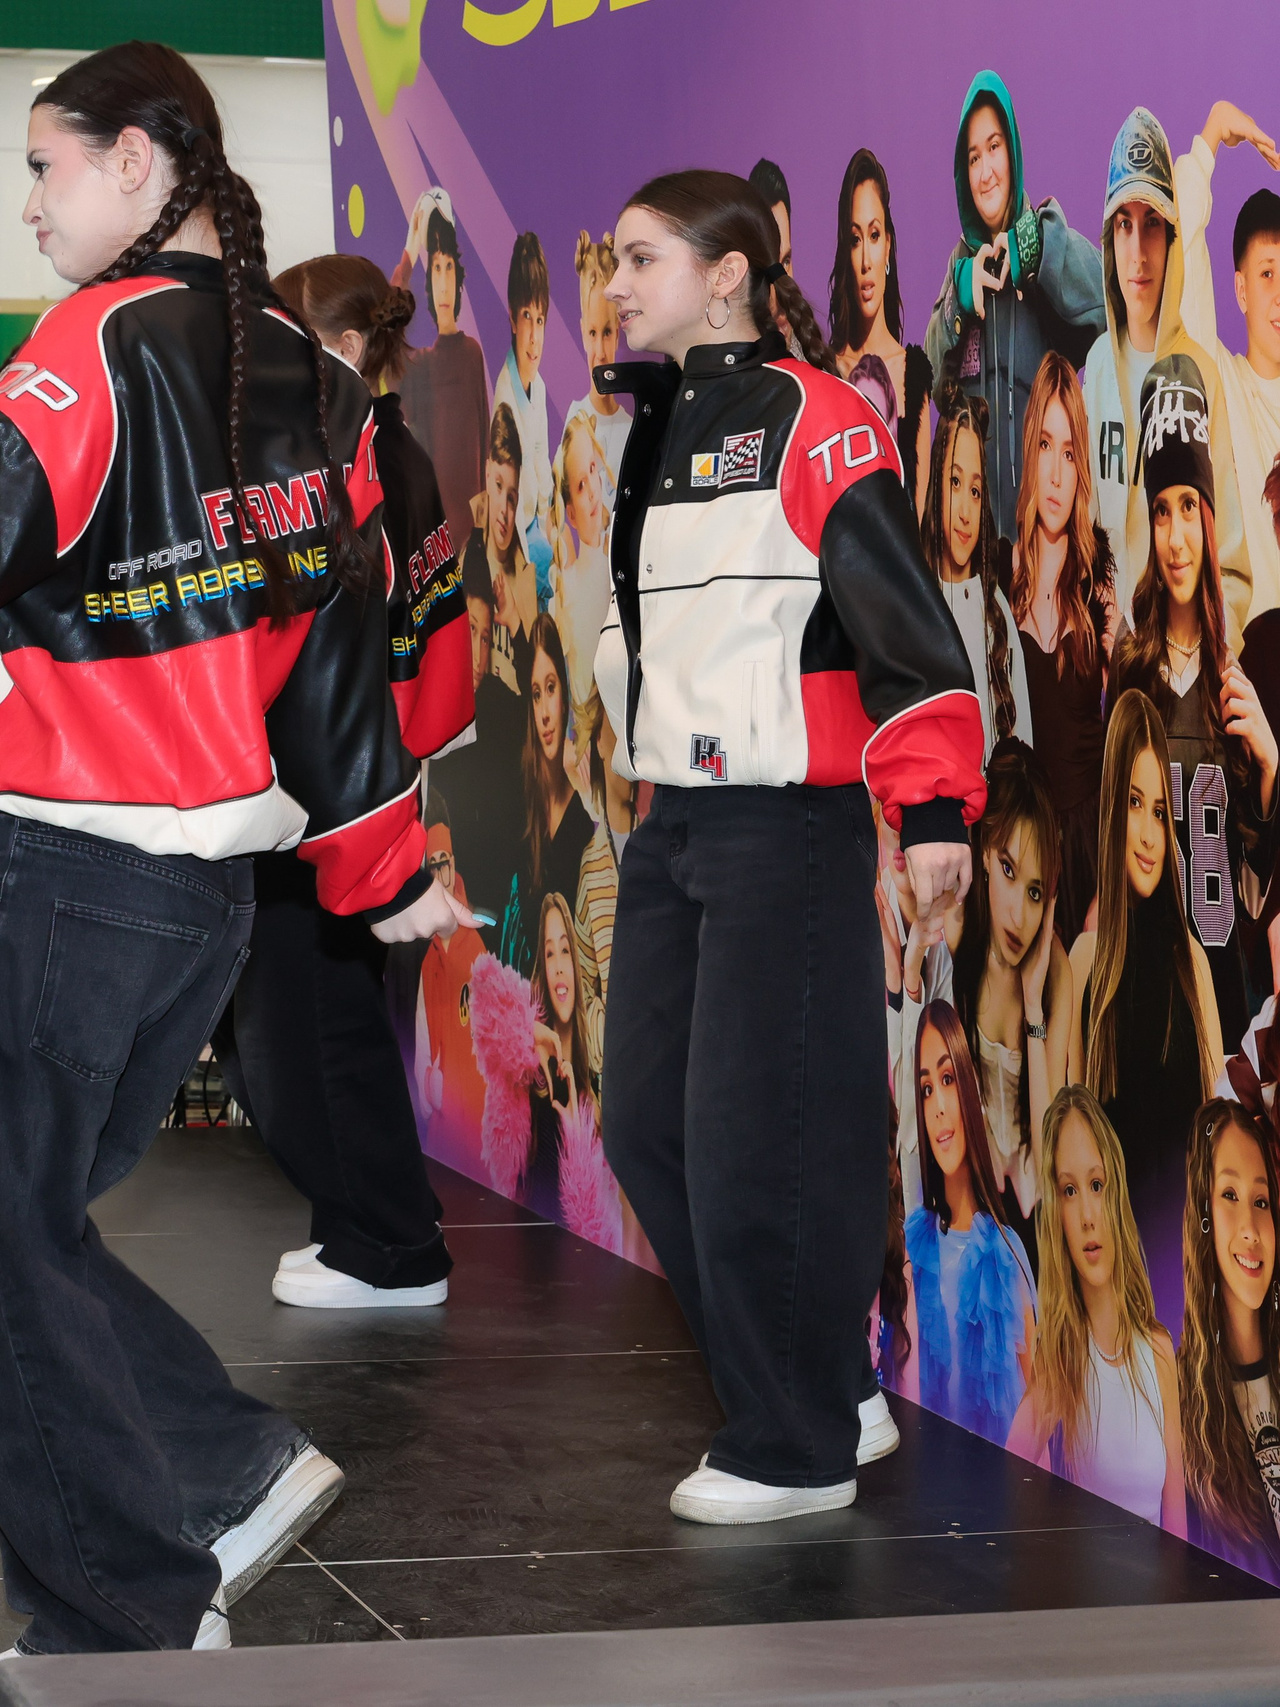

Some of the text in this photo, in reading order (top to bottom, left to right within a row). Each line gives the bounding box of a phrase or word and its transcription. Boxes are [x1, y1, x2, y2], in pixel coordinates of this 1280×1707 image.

[807, 424, 887, 485] TO
[146, 539, 203, 573] ROAD
[84, 580, 172, 623] SHEER
